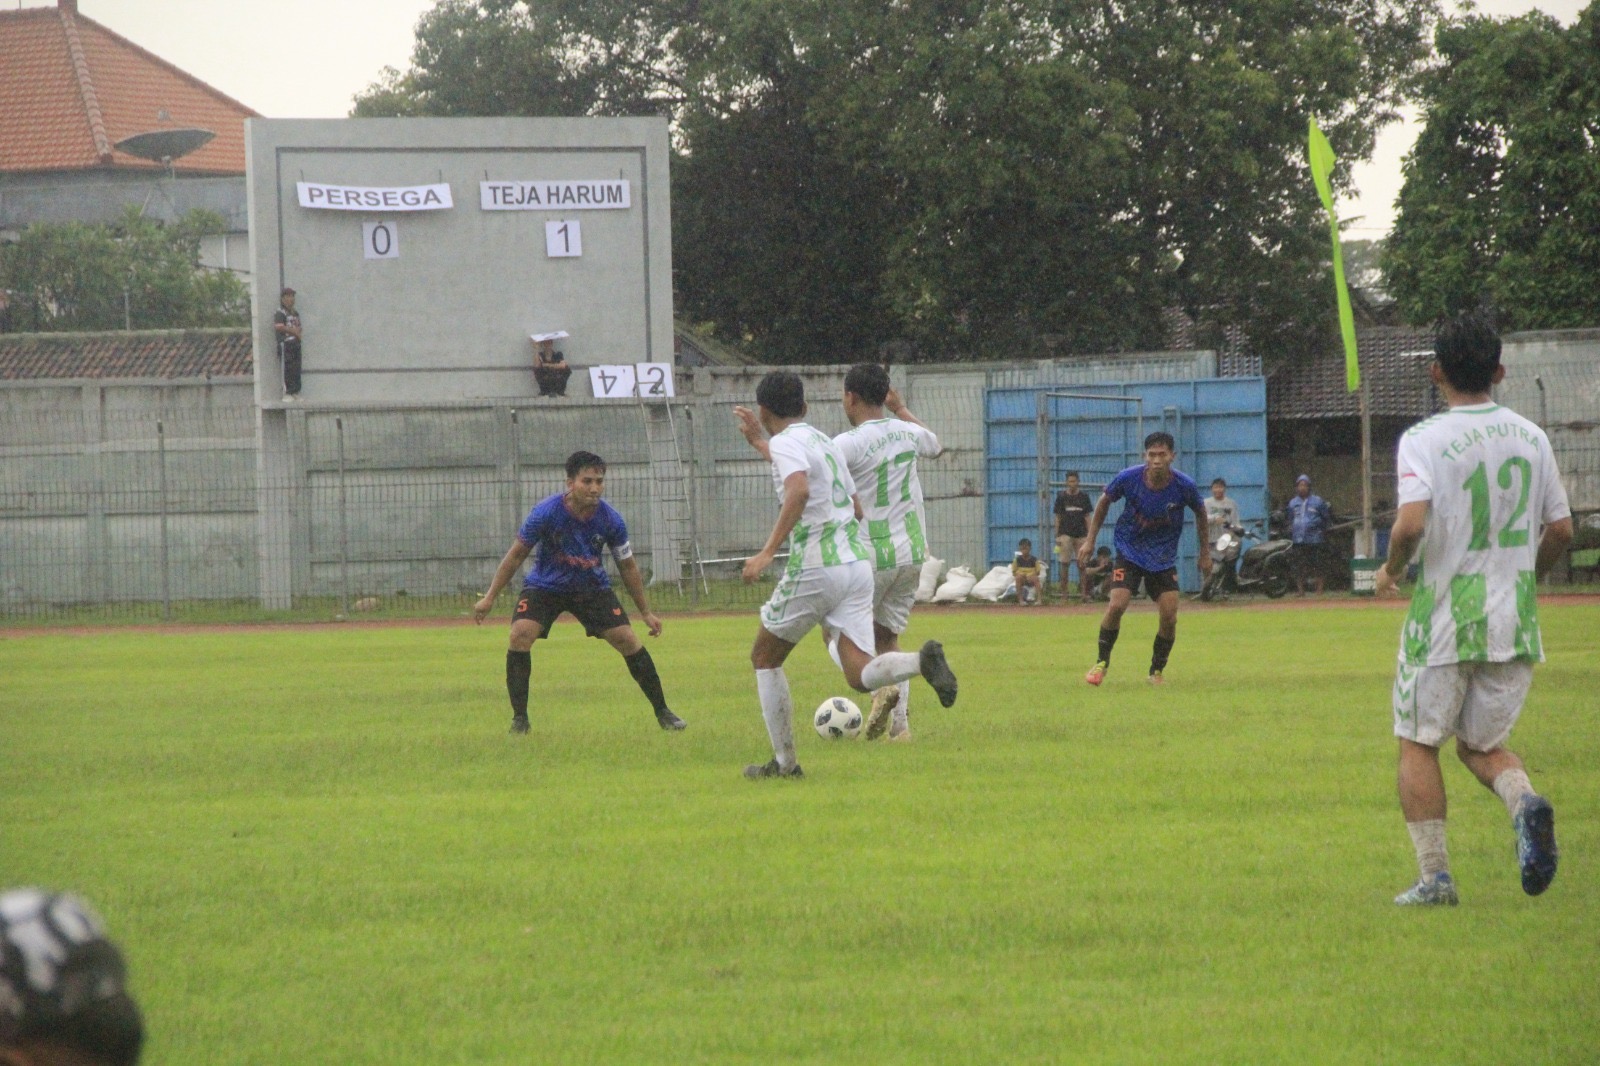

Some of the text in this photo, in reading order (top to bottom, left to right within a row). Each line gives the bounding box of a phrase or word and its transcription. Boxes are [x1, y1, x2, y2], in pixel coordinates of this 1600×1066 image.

[308, 187, 442, 207] PERSEGA
[488, 185, 623, 205] TEJA HARUM
[371, 225, 391, 255] 0
[557, 223, 570, 253] 1
[598, 370, 618, 395] 4
[865, 430, 920, 459] TEJA PUTRA
[1441, 422, 1539, 462] TEJA PUTRA
[825, 453, 852, 508] 8
[873, 450, 915, 507] 17
[1462, 456, 1533, 552] 12
[1113, 568, 1125, 582] 15
[516, 598, 529, 613] 5
